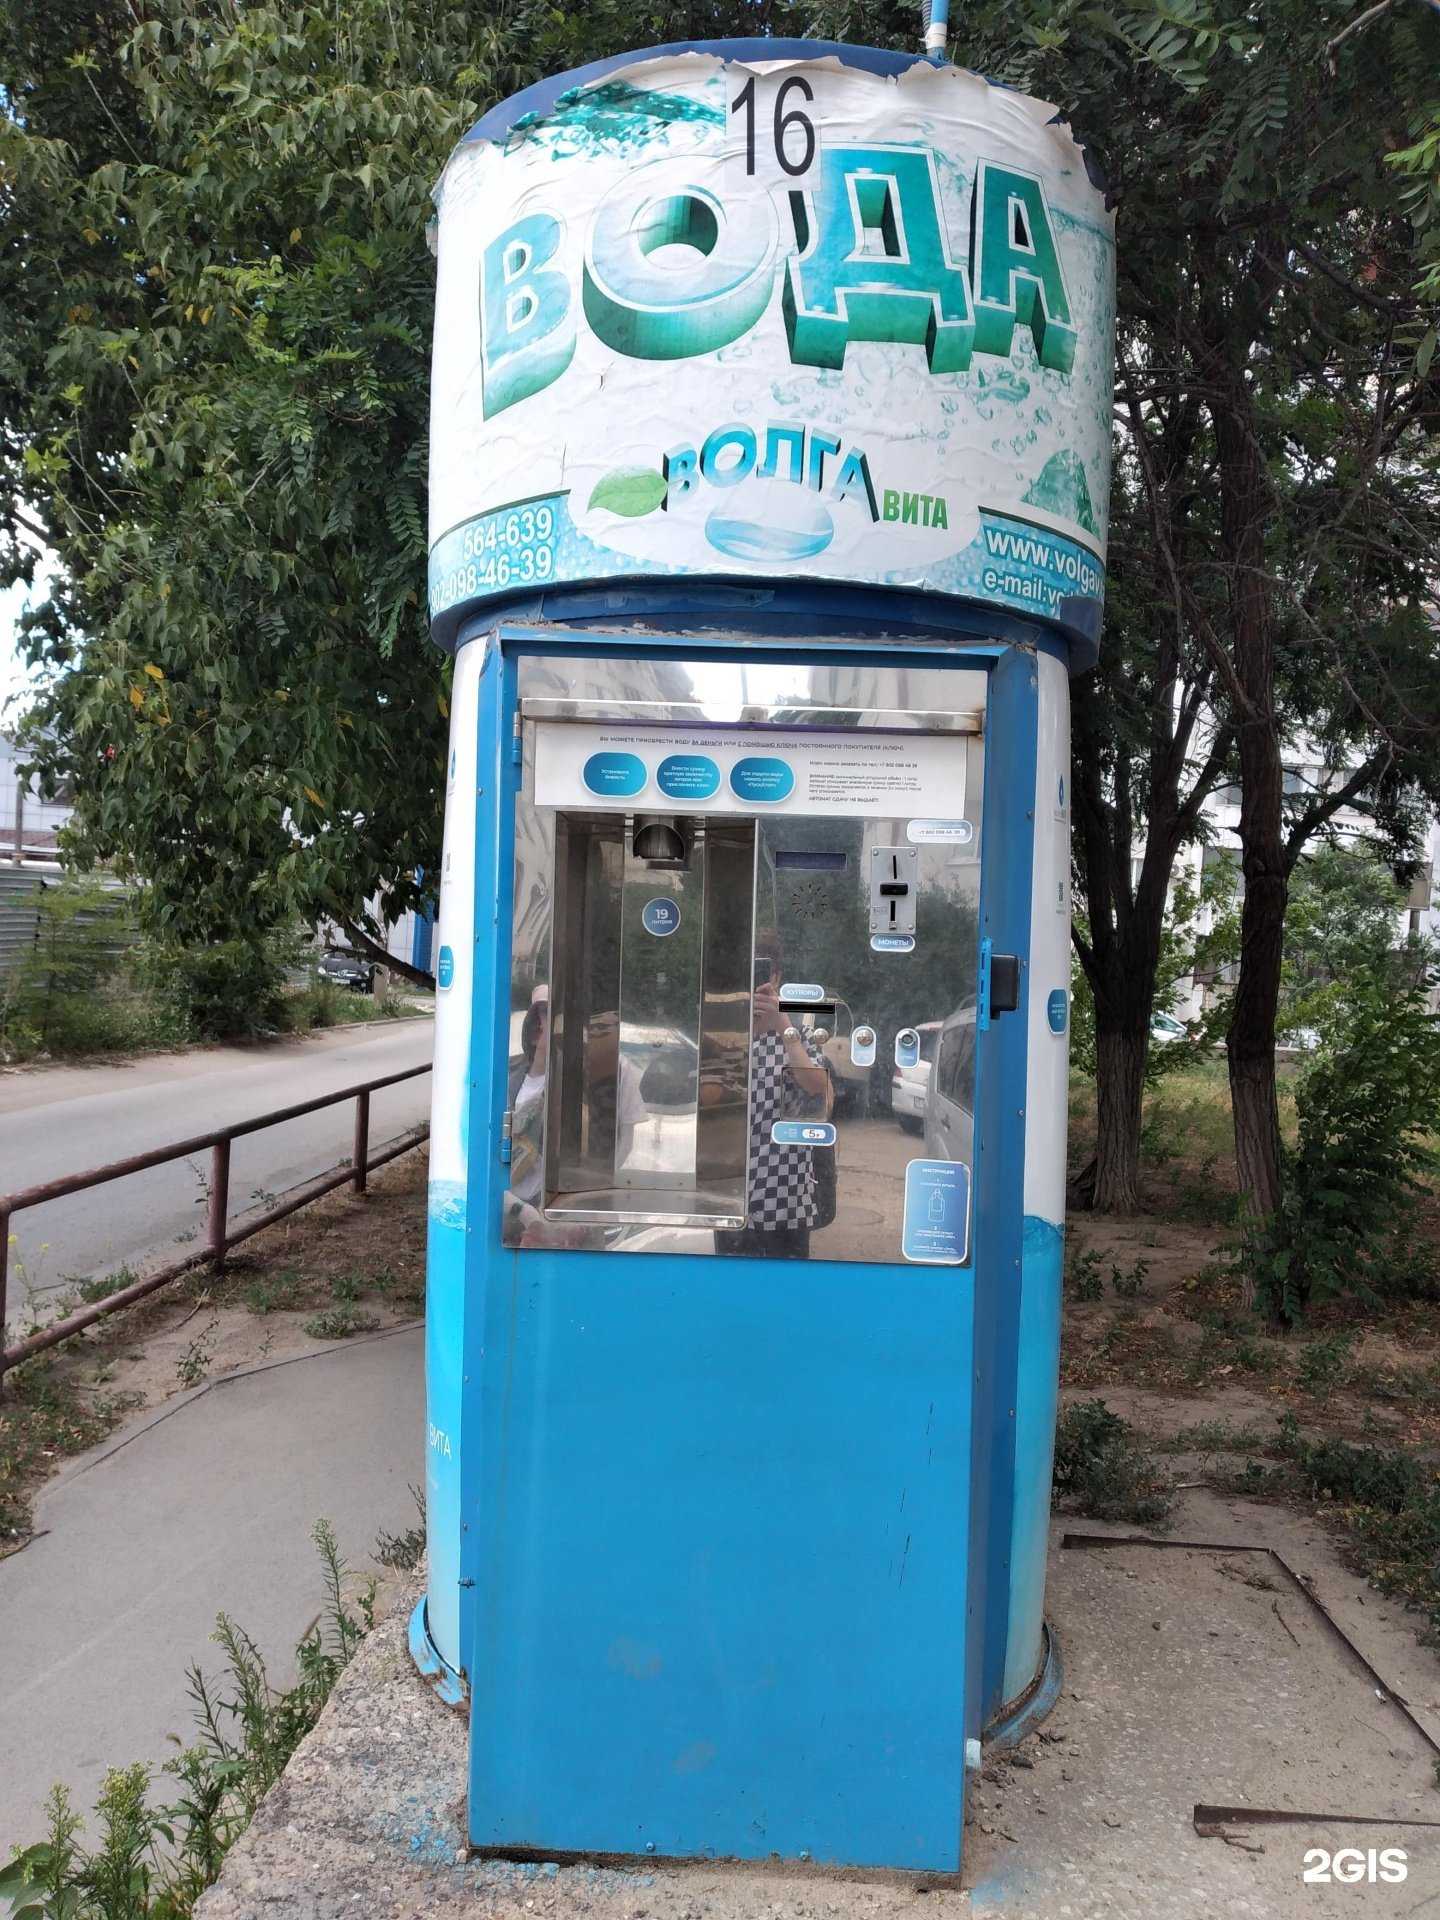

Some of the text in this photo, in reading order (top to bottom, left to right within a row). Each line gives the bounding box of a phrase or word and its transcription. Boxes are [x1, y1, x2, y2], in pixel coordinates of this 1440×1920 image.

[729, 76, 817, 176] 16
[479, 142, 1077, 421] ВОДА
[661, 418, 949, 530] ВОЛГА ВИТА
[463, 506, 553, 561] 564-639
[655, 908, 669, 920] 19
